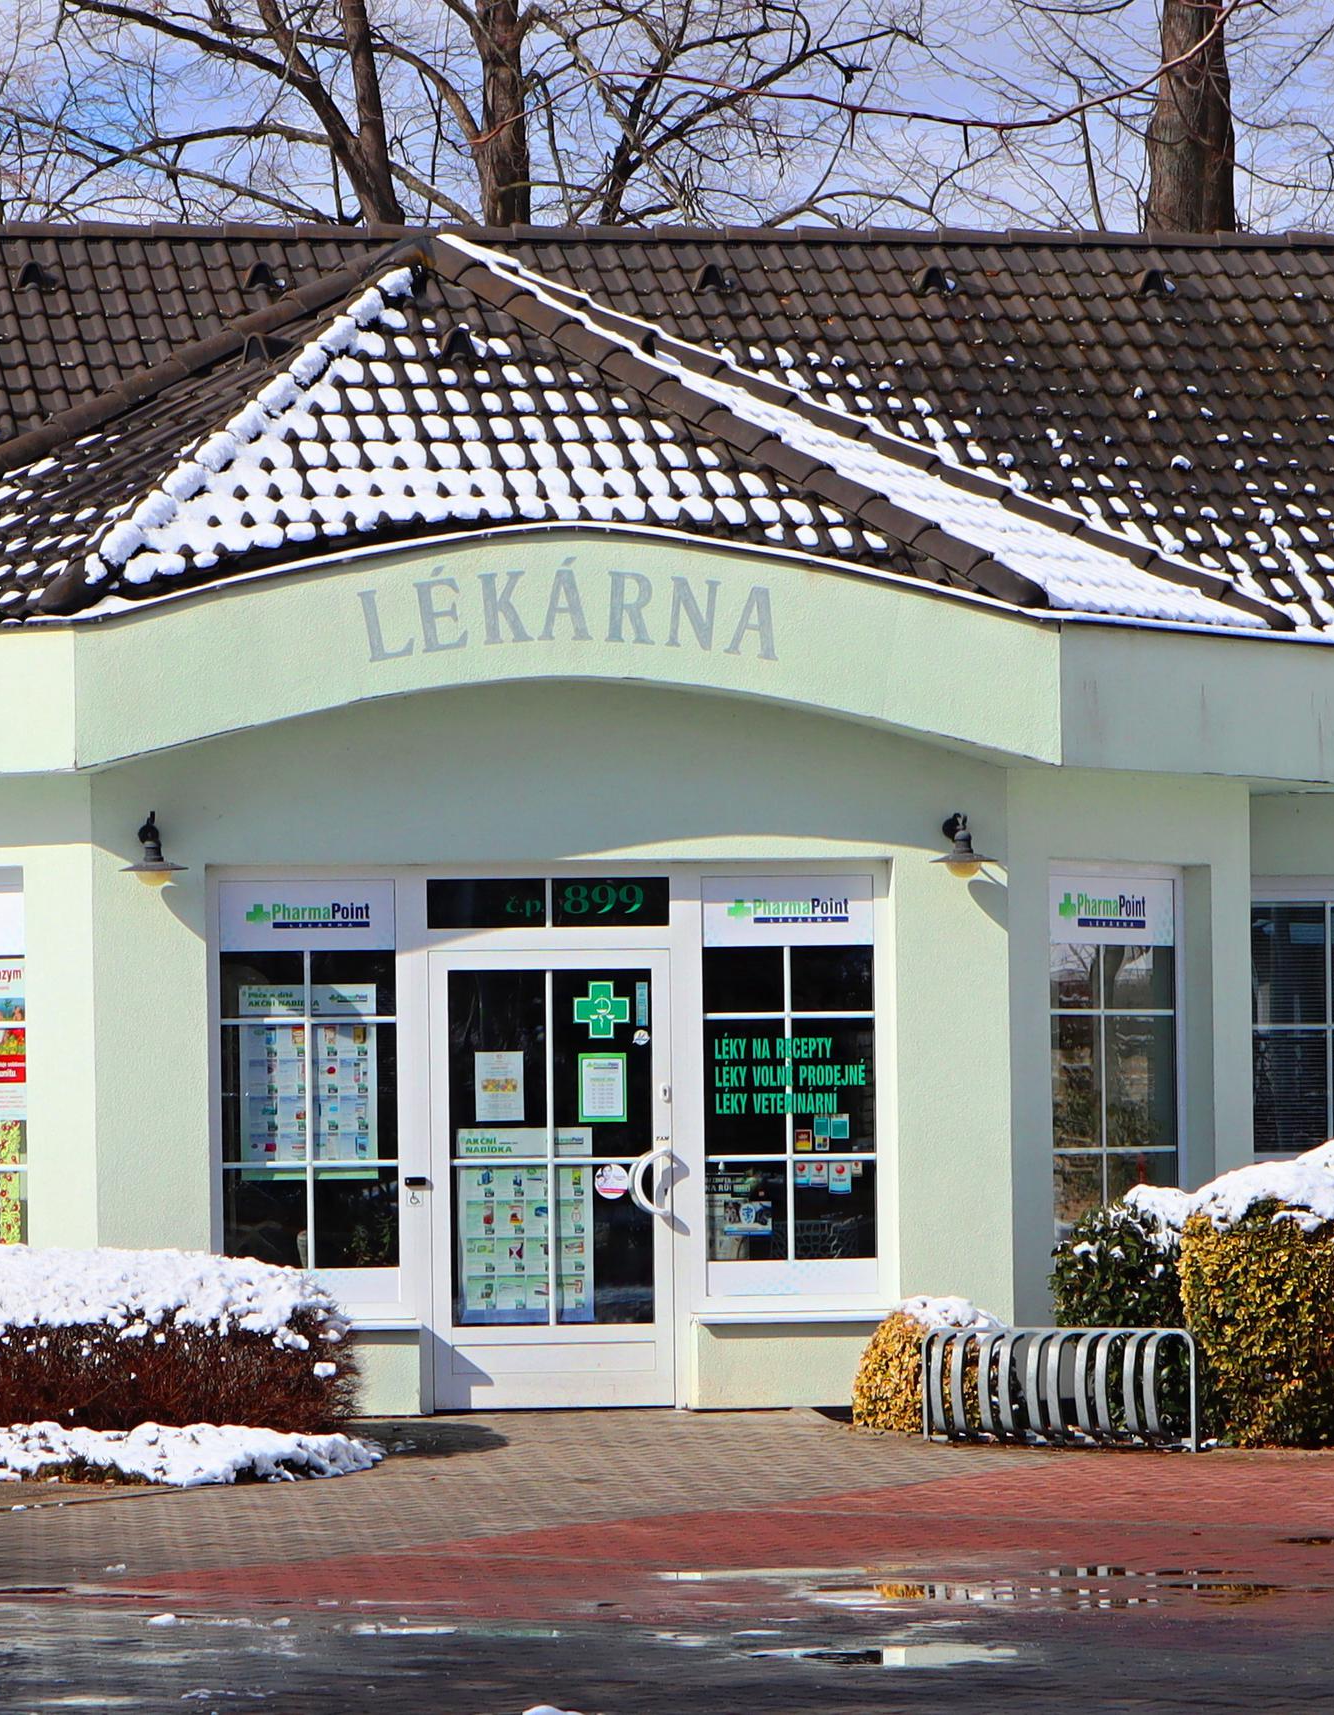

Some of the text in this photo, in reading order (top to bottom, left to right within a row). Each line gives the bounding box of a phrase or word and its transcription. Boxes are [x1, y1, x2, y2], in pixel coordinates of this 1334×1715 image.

[357, 556, 779, 663] LÉKÁRNA
[272, 902, 370, 920] PharmaPoint
[563, 884, 644, 914] 899
[753, 898, 849, 915] PharmaPoint
[1077, 893, 1146, 917] PharmaPoint
[714, 1032, 832, 1060] LÉKY NA RECEPTY
[715, 1061, 747, 1087] LÉKY
[799, 1058, 866, 1086] PRODEJNÉ
[715, 1087, 838, 1115] LÉKY VETERINÁRNÍ
[465, 1136, 497, 1145] AKČNÍ
[465, 1145, 513, 1153] NABÍDKA
